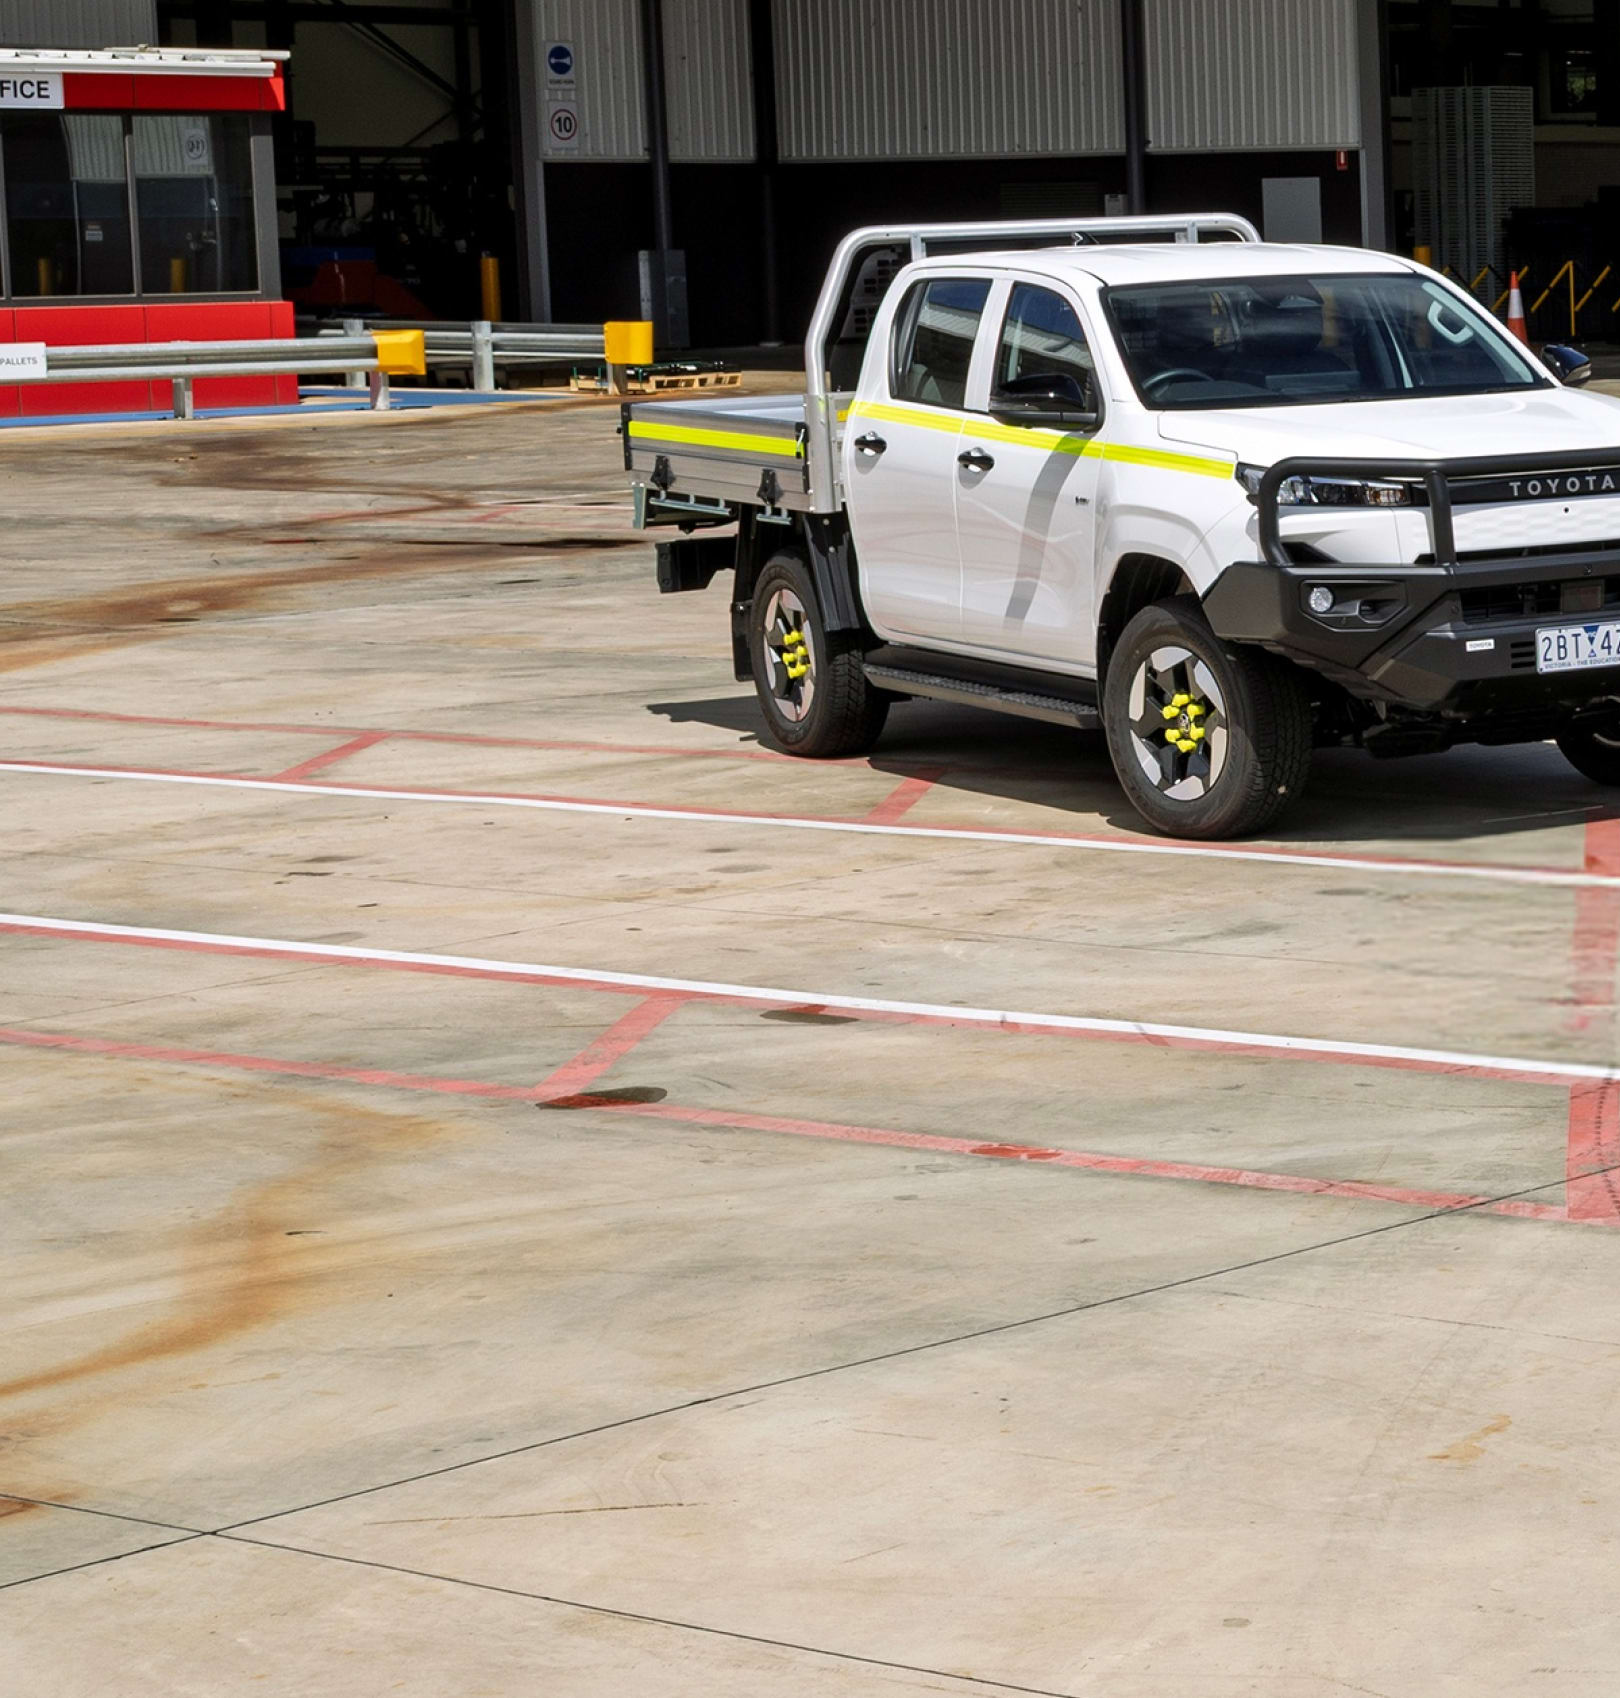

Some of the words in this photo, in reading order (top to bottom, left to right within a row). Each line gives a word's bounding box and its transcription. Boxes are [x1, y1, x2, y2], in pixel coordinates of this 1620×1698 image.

[0, 80, 50, 98] FICE
[555, 116, 573, 133] 10
[1509, 474, 1616, 496] TOYOTA
[1541, 633, 1582, 662] 2BT
